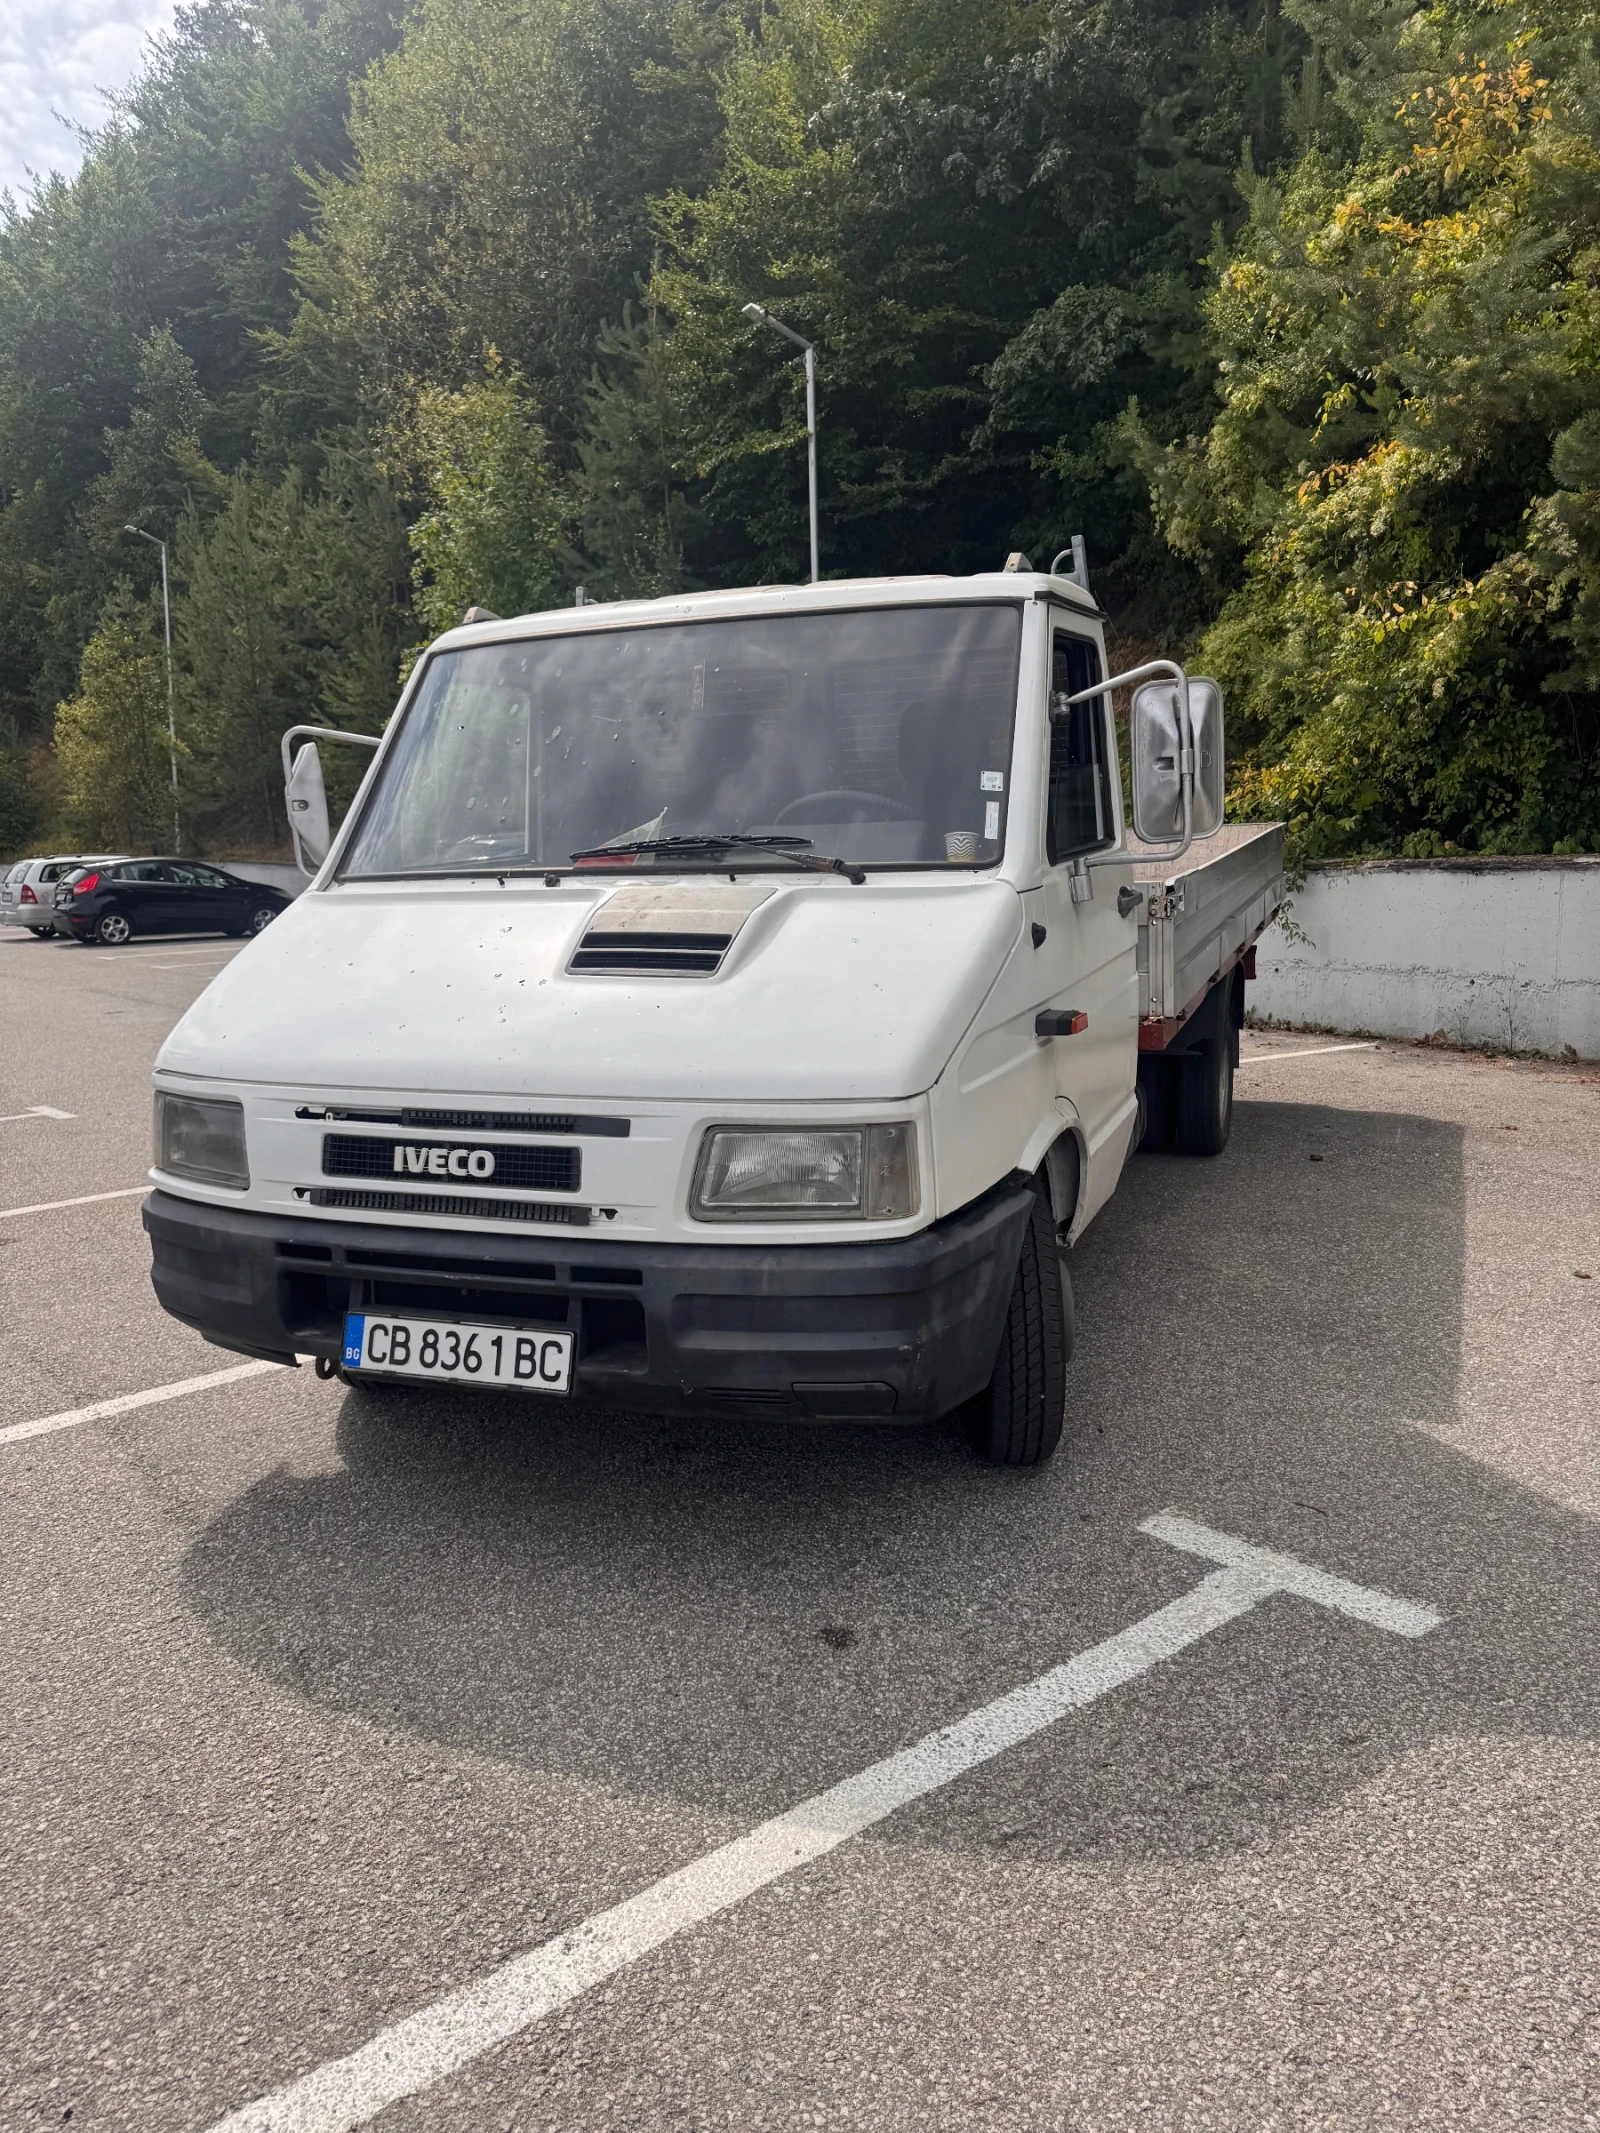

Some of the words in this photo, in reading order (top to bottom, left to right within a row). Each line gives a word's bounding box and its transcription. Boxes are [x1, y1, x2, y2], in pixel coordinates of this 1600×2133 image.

[393, 1146, 496, 1178] IVECO
[345, 1346, 361, 1361] BG
[367, 1323, 411, 1366] CB
[419, 1328, 503, 1377] 8361
[514, 1337, 563, 1383] BC
